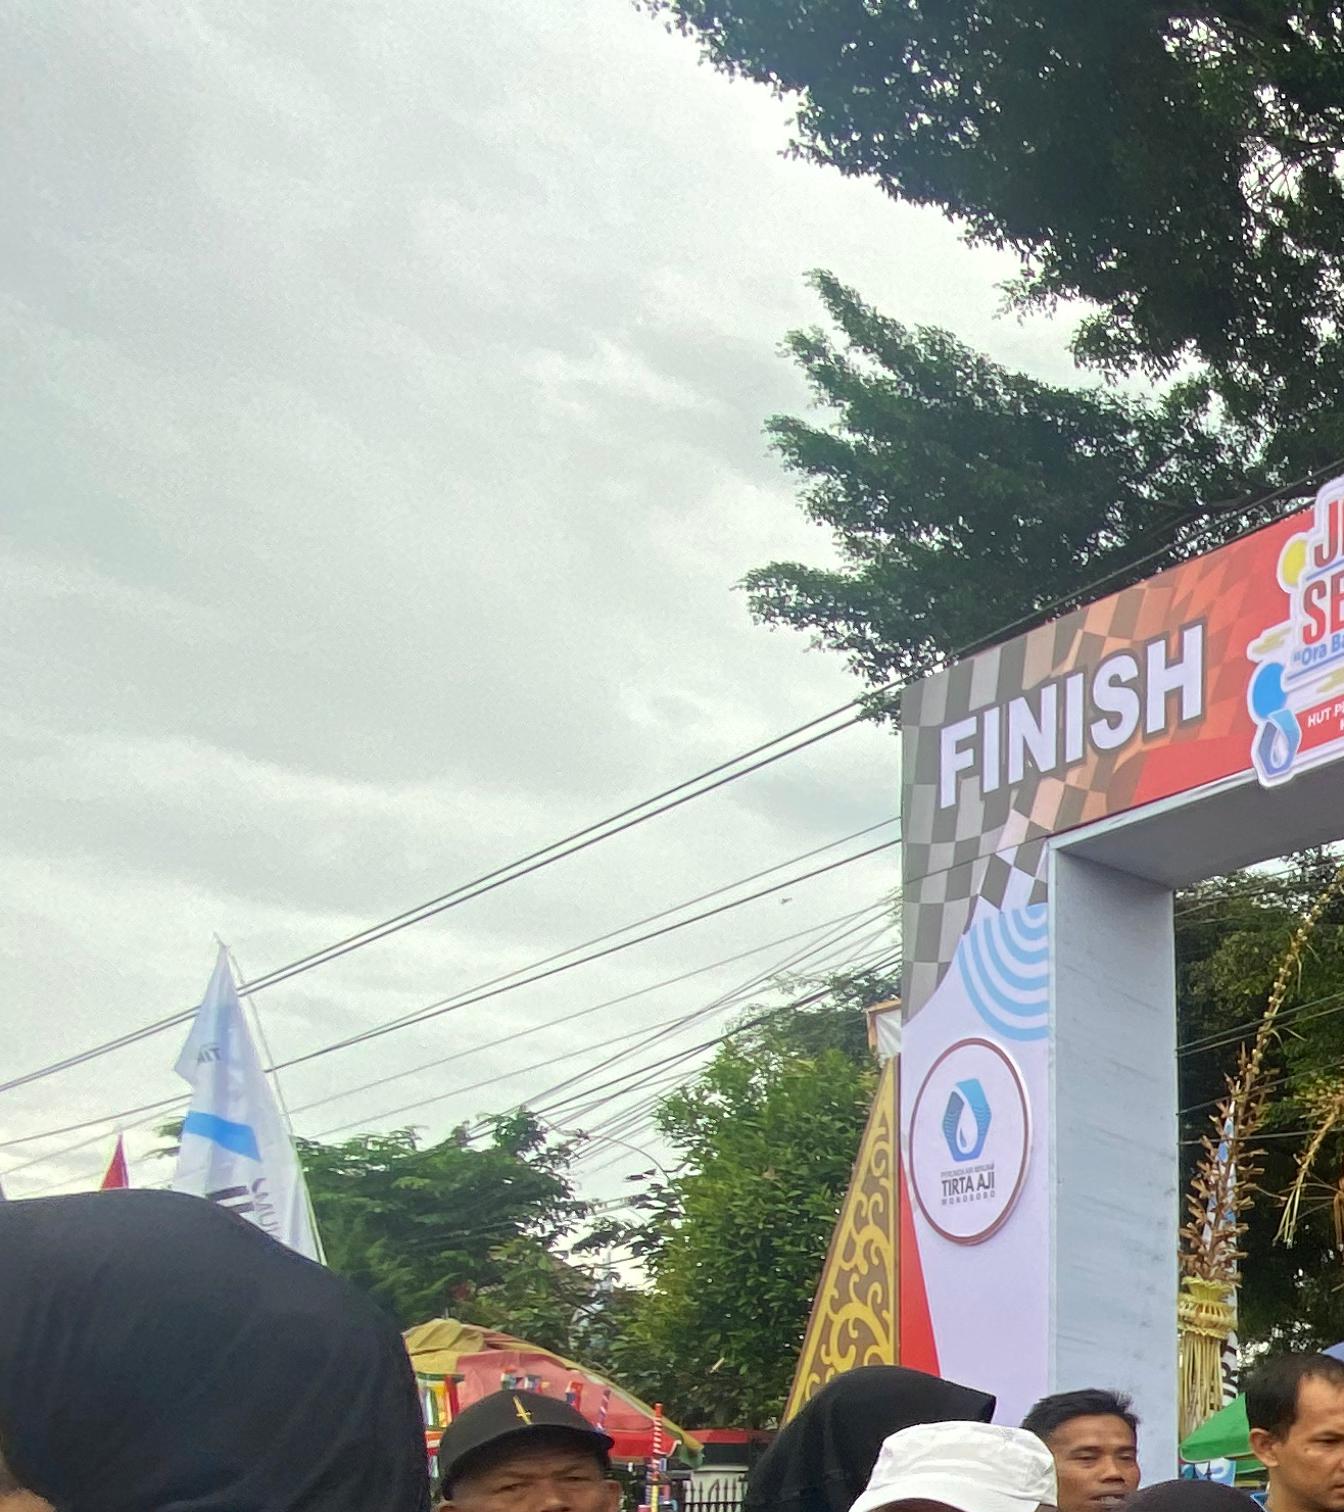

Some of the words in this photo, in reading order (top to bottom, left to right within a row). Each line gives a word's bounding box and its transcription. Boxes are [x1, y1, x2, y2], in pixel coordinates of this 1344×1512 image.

[940, 624, 1203, 810] FINISH
[1307, 707, 1332, 729] HUT
[941, 1175, 975, 1198] TIRTA
[976, 1171, 995, 1192] AJI
